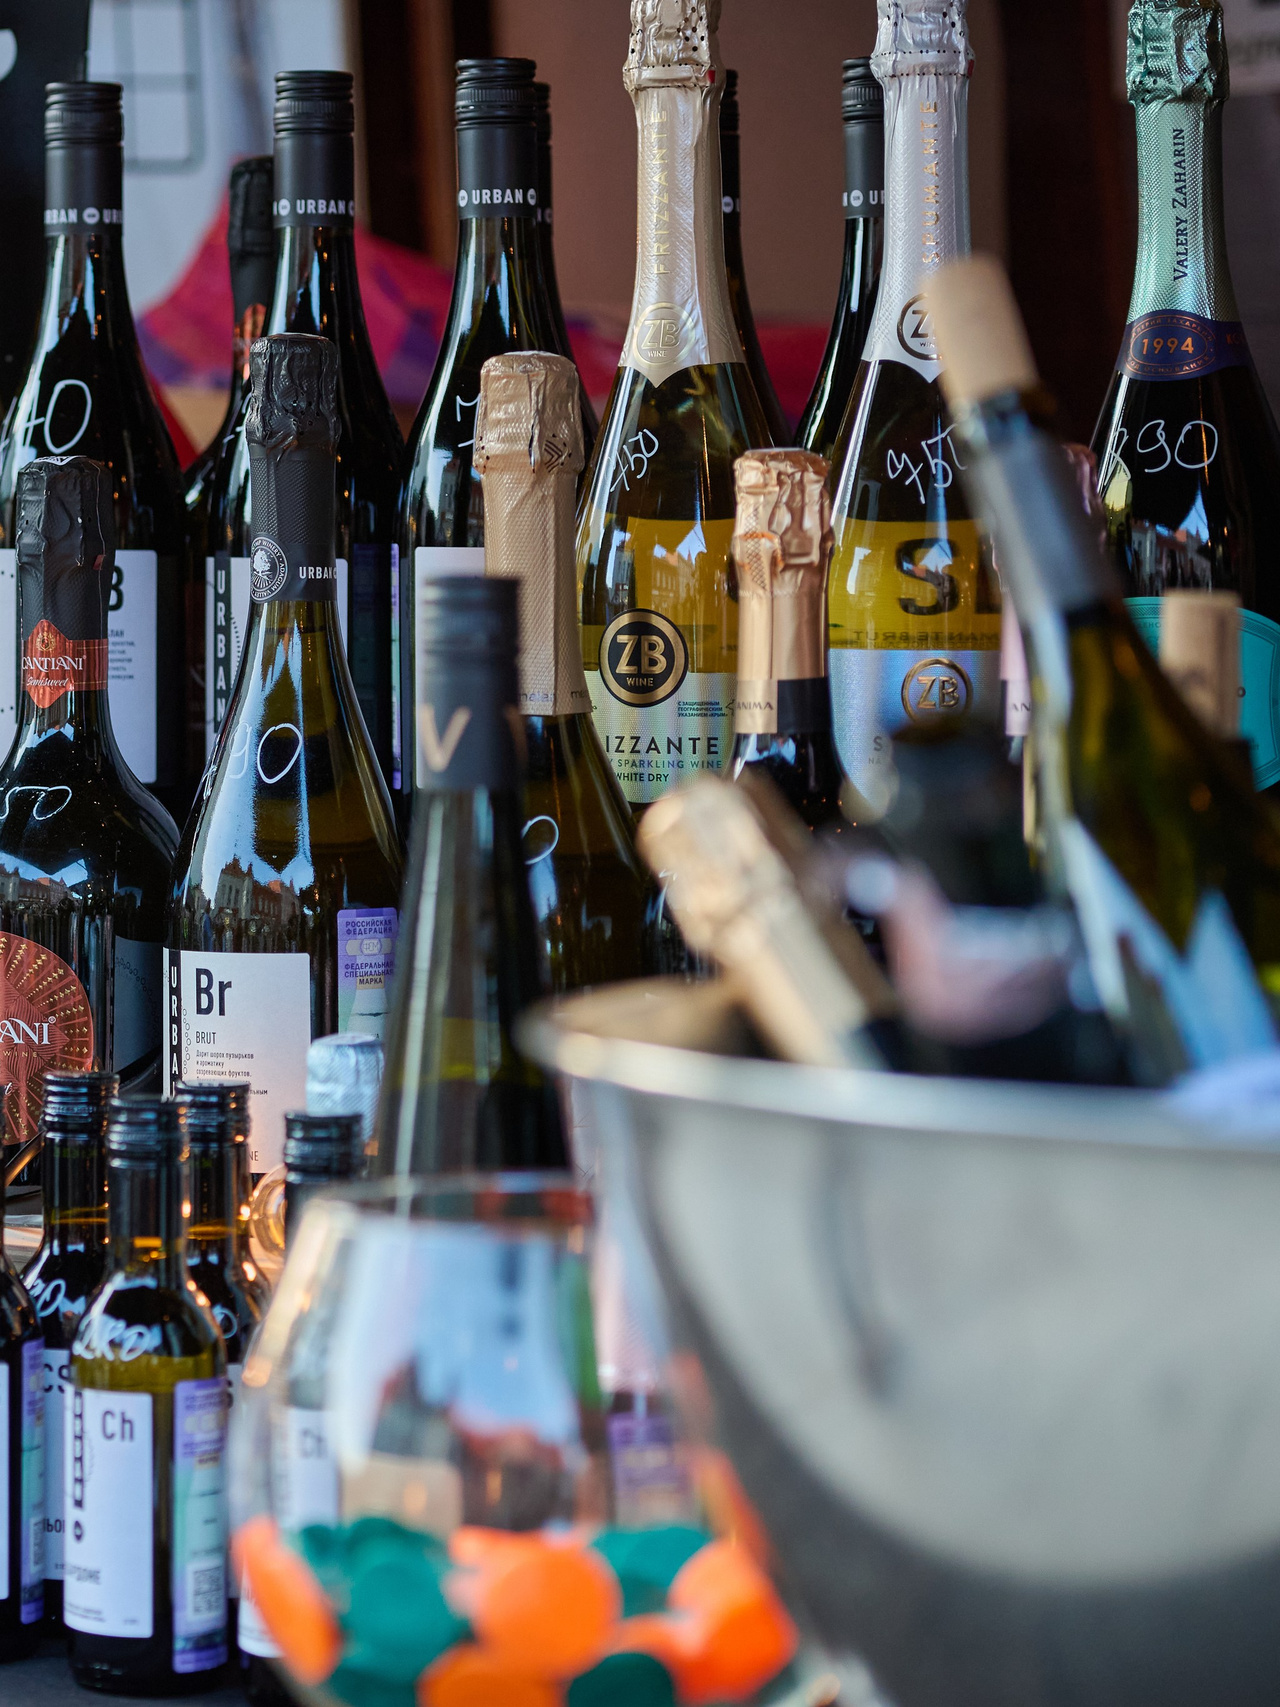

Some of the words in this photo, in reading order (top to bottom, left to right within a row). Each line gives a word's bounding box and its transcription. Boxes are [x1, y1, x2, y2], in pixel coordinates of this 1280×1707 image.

[1172, 128, 1187, 211] ZAHARIN
[922, 99, 940, 265] SPUMANTE
[472, 188, 523, 205] URBAN
[651, 109, 670, 275] FRIZZANTE
[297, 199, 345, 215] URBAN
[1173, 215, 1188, 282] VALERY
[641, 318, 680, 350] ZB
[647, 350, 667, 358] WINE
[1141, 336, 1195, 355] 1994
[216, 569, 227, 722] URBAN
[615, 634, 668, 675] ZB
[626, 677, 654, 688] WINE
[916, 676, 960, 709] ZB
[605, 735, 720, 755] IZZANTE
[618, 759, 685, 769] SPARKLING
[690, 760, 723, 769] WINE
[647, 773, 670, 783] DRY
[345, 919, 393, 929] РОССИЙСКАЯ
[345, 927, 393, 936] ФЕДЕРАЦИЯ
[195, 967, 233, 1017] Br
[195, 1031, 217, 1045] BRUT
[2, 1050, 39, 1058] WINE
[101, 1410, 135, 1443] Ch
